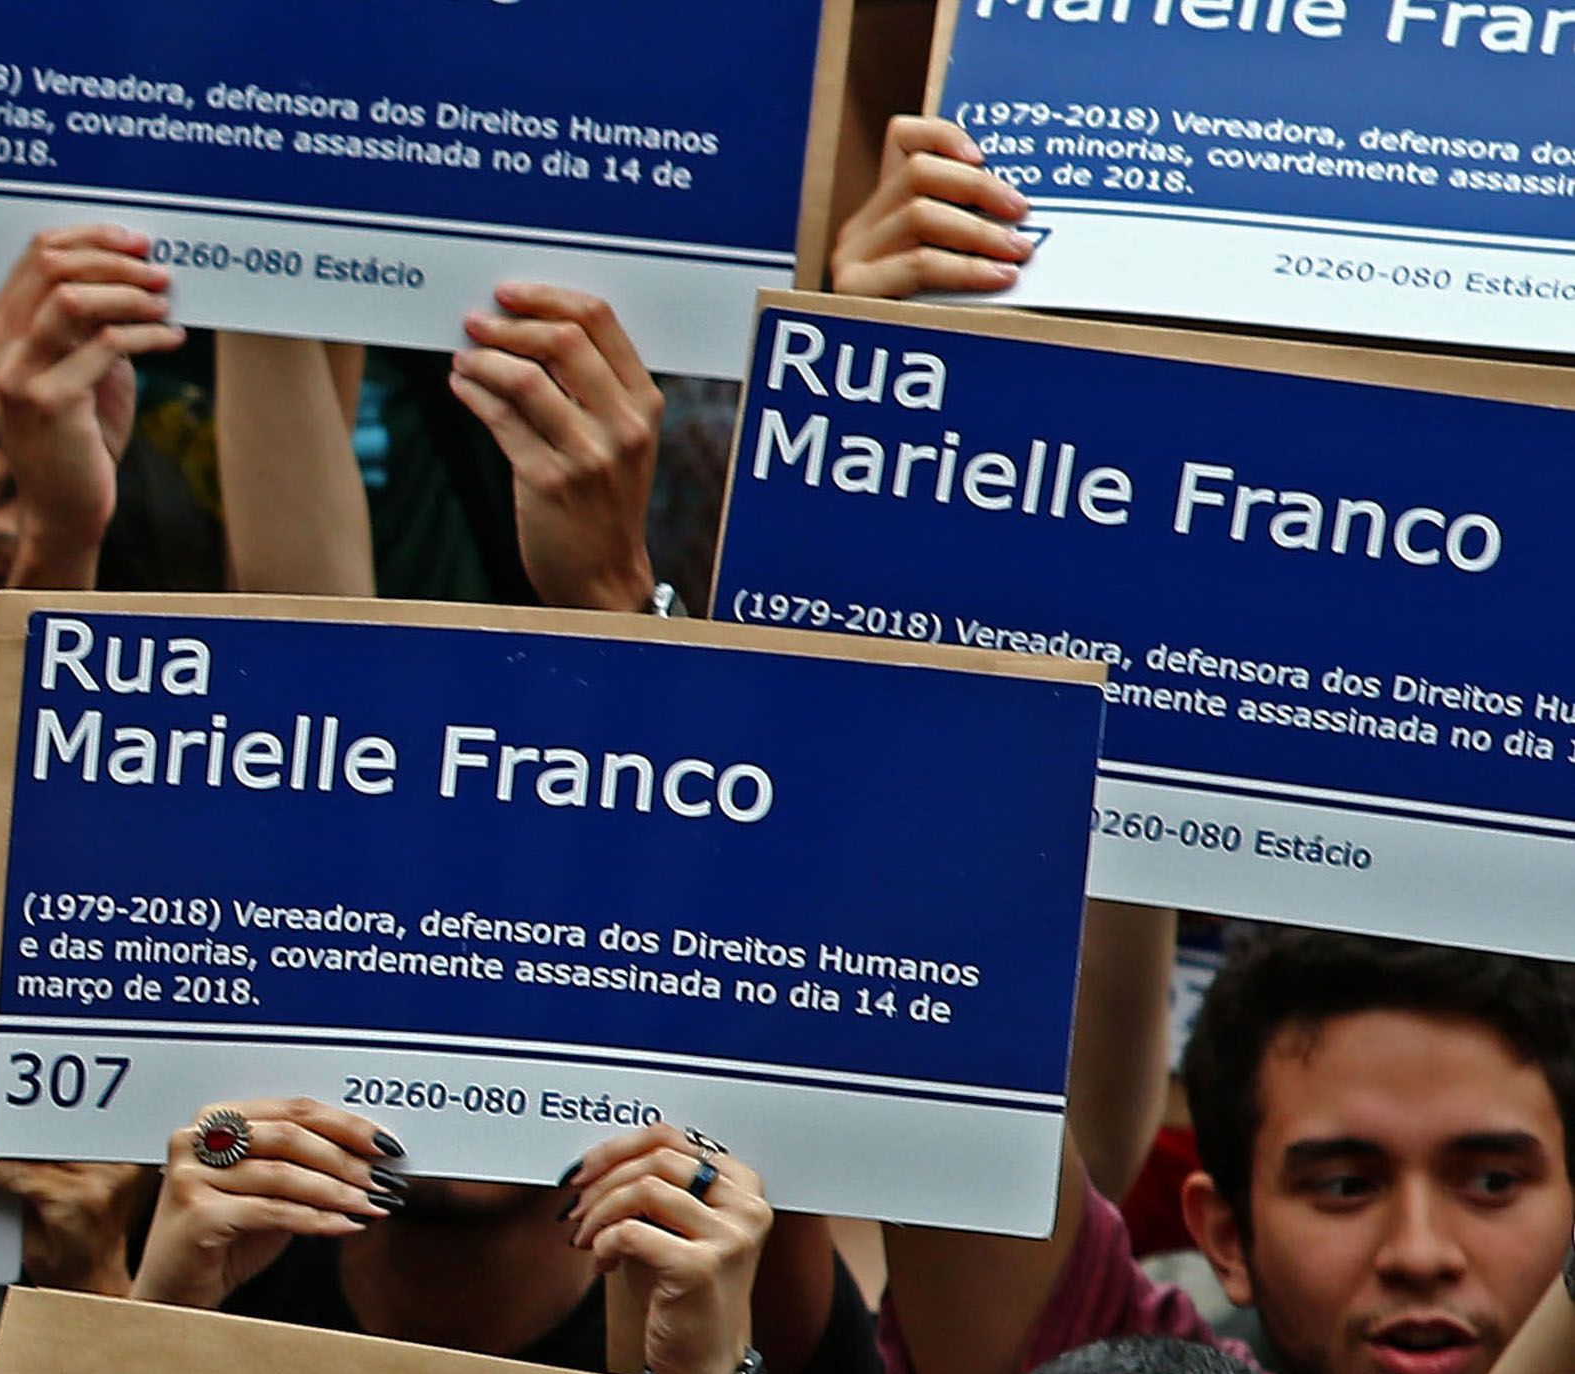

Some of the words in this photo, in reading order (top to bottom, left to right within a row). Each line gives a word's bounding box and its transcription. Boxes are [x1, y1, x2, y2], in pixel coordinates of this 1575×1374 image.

[32, 67, 195, 111] Vereadora,
[207, 82, 358, 120] defensora
[369, 96, 426, 126] dos
[435, 102, 559, 139] Direitos
[570, 115, 720, 154] Humanos
[68, 112, 284, 150] covardemente
[293, 131, 480, 169] assassinada
[491, 150, 531, 173] no
[541, 149, 589, 179] dia
[602, 156, 642, 184] 14
[652, 160, 693, 189] de
[1172, 111, 1345, 150] Vereadora,
[1358, 127, 1520, 161] defensora
[768, 319, 946, 410] Rua
[752, 407, 1132, 526] Marielle
[1173, 461, 1502, 572] Franco
[40, 618, 211, 696] Rua
[733, 588, 942, 647] (1979-2018)
[955, 617, 1132, 672] Vereadora,
[1146, 643, 1310, 690] defensora
[1321, 666, 1382, 698] dos
[1392, 674, 1524, 717] Direitos
[32, 708, 397, 795] Marielle
[439, 725, 774, 822] Franco
[20, 936, 39, 958] e
[49, 931, 104, 961] das
[114, 935, 258, 972] minorias,
[270, 944, 504, 980] covardemente
[514, 960, 721, 999] assassinada
[734, 980, 777, 1005] no
[789, 980, 841, 1012] dia
[855, 988, 898, 1018] 14
[909, 993, 951, 1025] de
[23, 891, 221, 932] (1979-2018)
[232, 900, 407, 940] Vereadora,
[420, 909, 586, 948] defensora
[598, 922, 660, 954] dos
[671, 929, 807, 968] Direitos
[819, 943, 979, 987] Humanos
[18, 975, 113, 1005] março
[123, 972, 161, 1002] de
[171, 975, 260, 1005] 2018.
[8, 1052, 130, 1109] 307
[343, 1077, 527, 1115] 20260-080
[539, 1091, 661, 1127] Estácio
